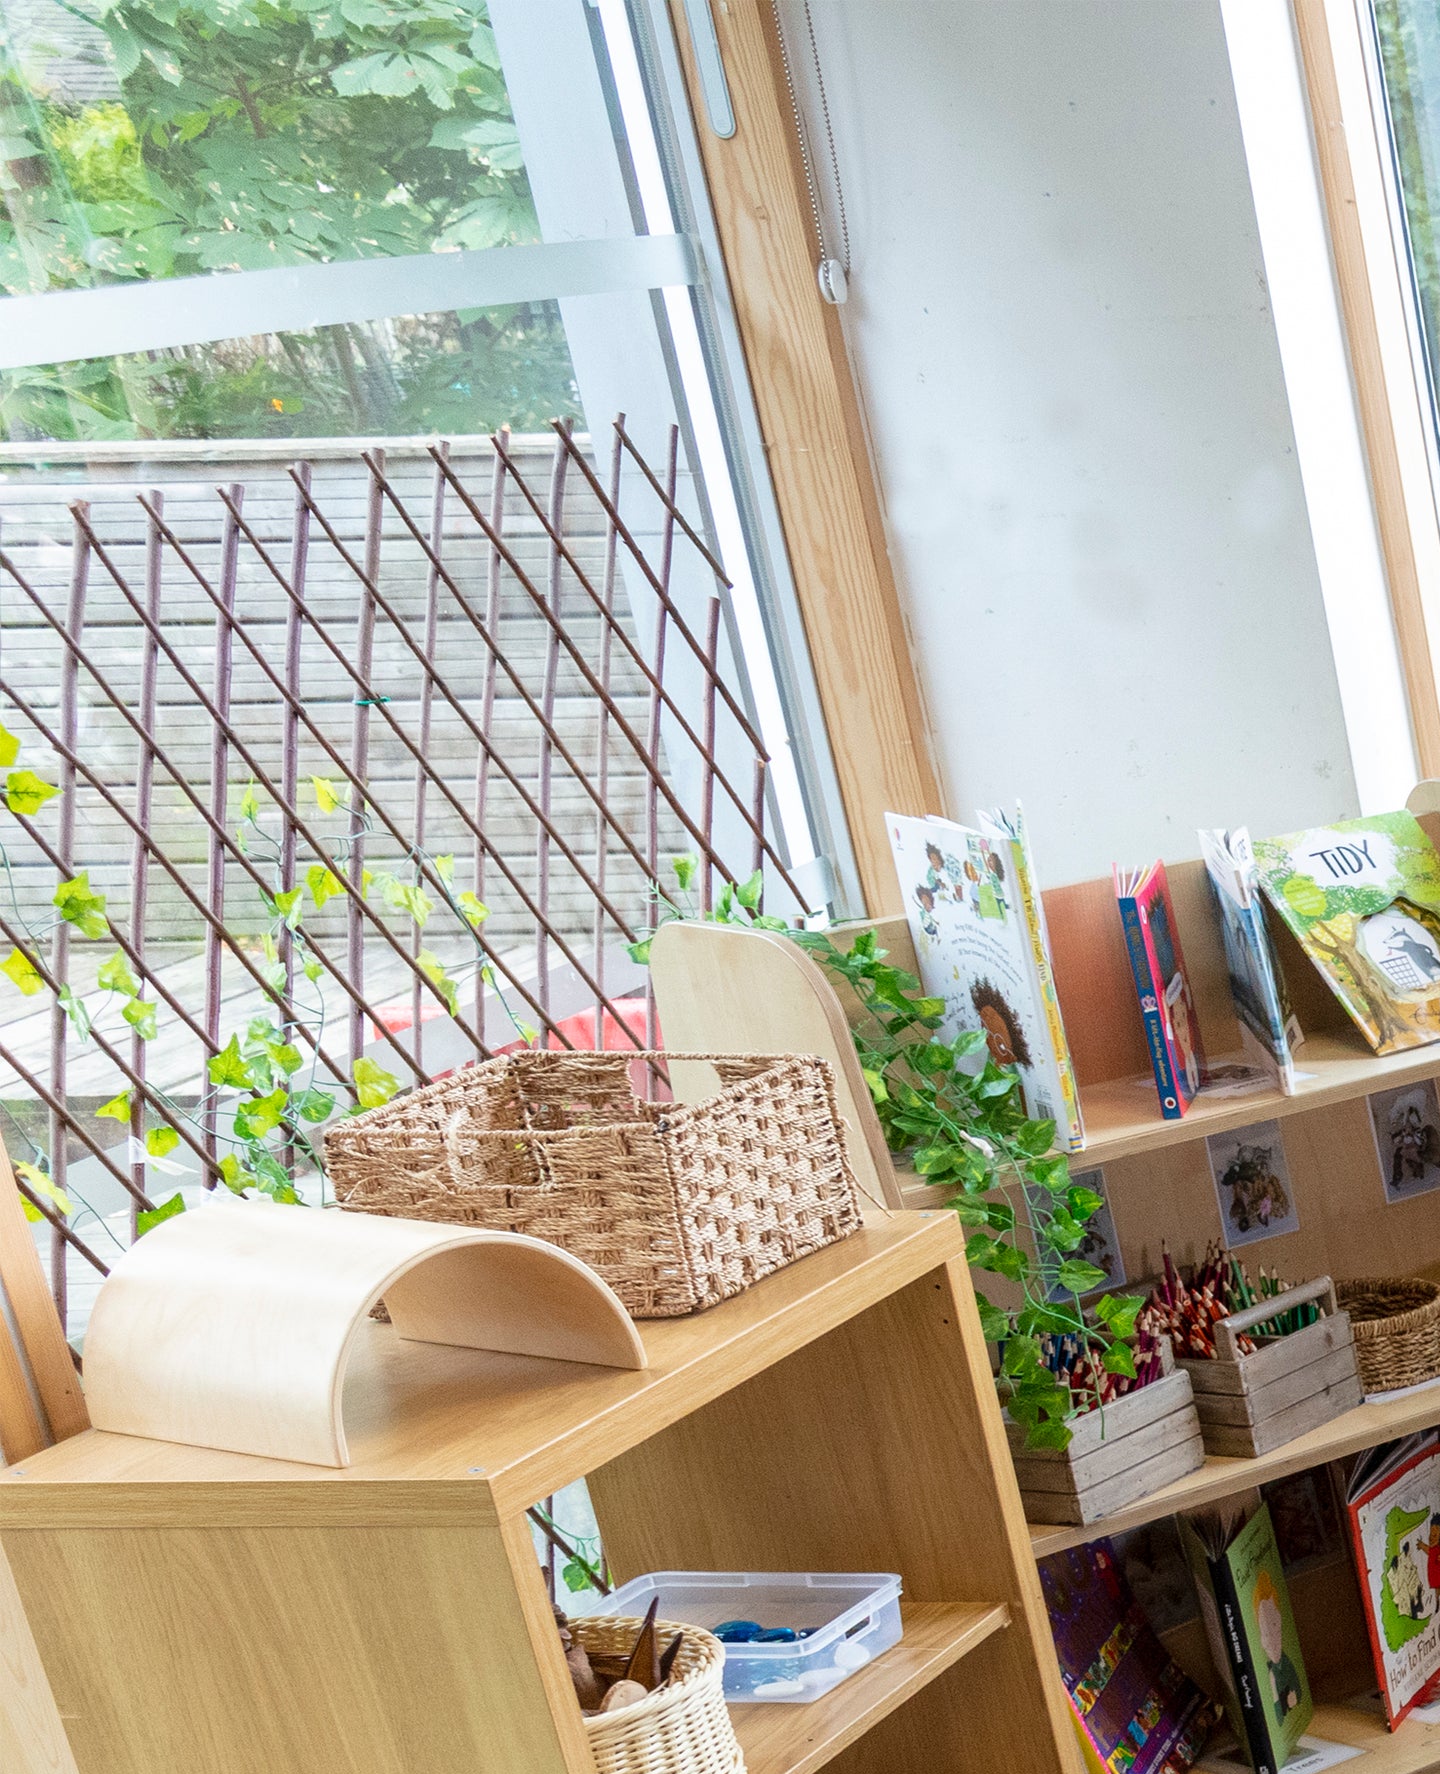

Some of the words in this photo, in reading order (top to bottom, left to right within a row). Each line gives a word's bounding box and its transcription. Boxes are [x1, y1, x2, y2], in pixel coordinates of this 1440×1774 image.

[1308, 839, 1376, 878] TIDY
[1390, 1664, 1406, 1692] How
[1408, 1650, 1417, 1671] to
[1417, 1628, 1436, 1657] Find
